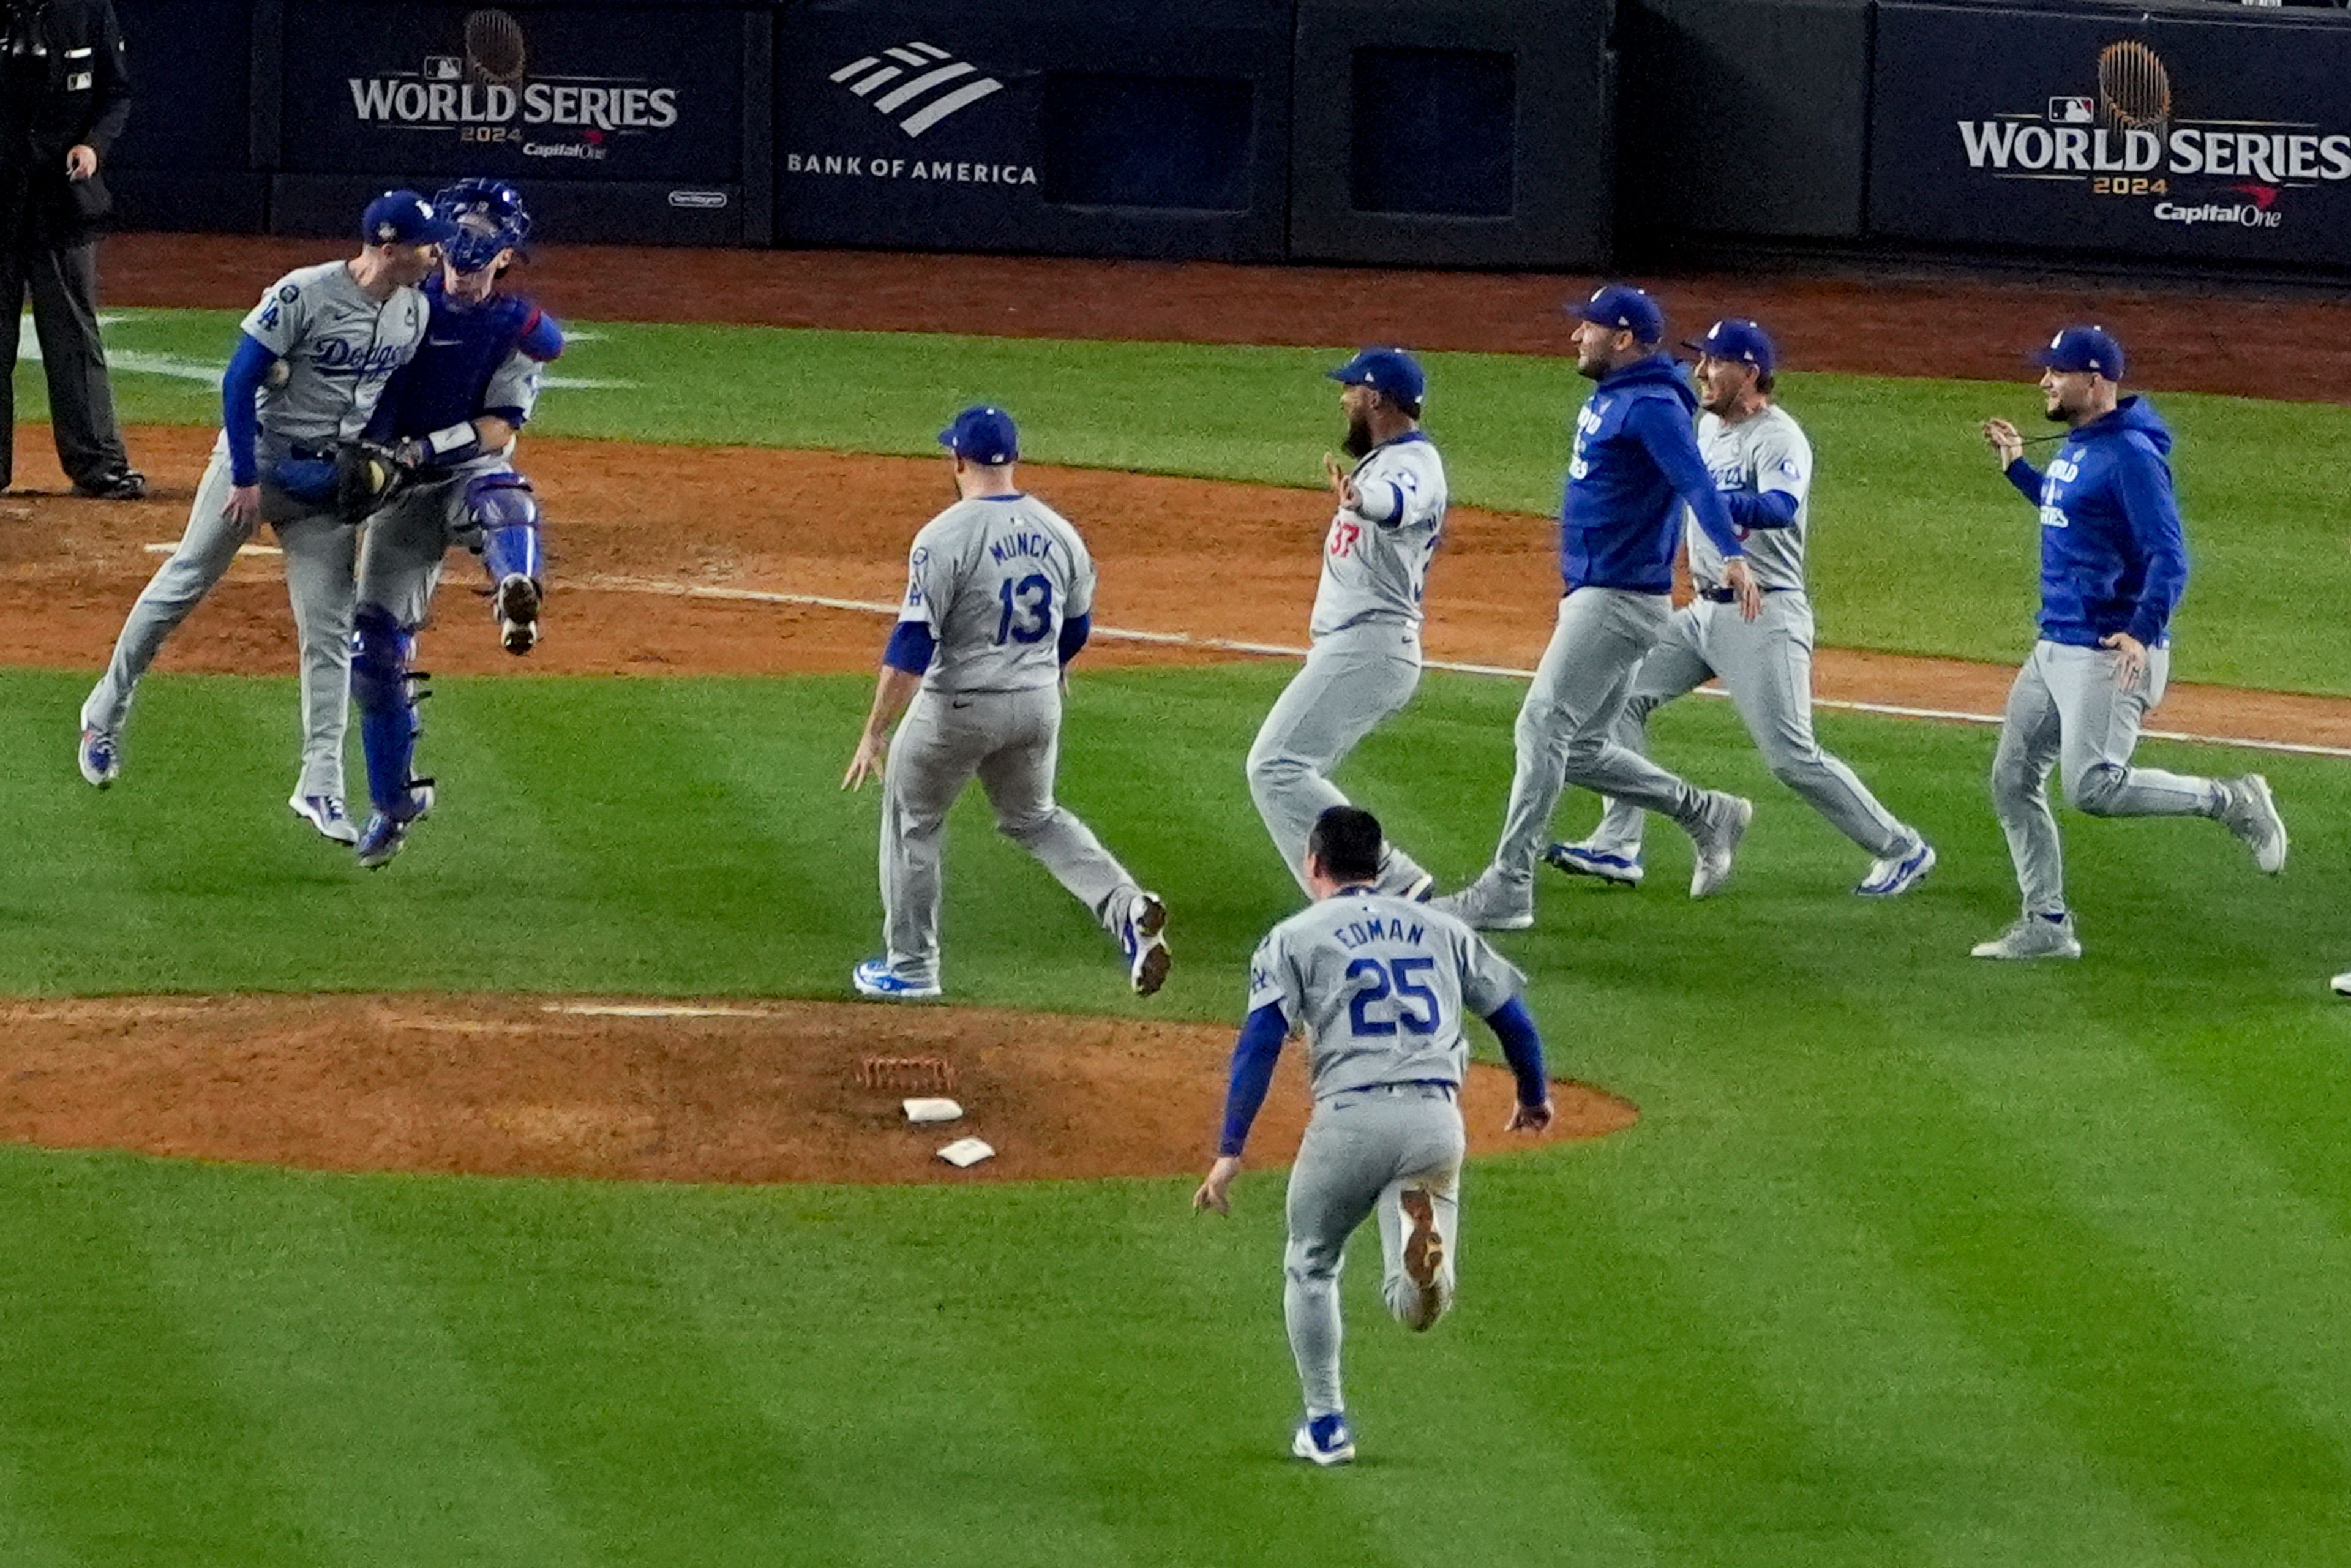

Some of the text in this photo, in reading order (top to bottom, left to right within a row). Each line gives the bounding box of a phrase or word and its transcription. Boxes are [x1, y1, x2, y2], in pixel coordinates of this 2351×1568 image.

[348, 78, 678, 130] WORLD SERIES
[461, 127, 522, 143] 2024
[1957, 121, 2351, 183] WORLD SERIES
[787, 153, 1037, 184] BANK OF AMERICA
[2093, 177, 2169, 195] 2024
[989, 532, 1053, 568] MUNCY
[1330, 520, 1360, 558] 37
[994, 573, 1053, 646] 13
[1334, 918, 1424, 950] EDMAN
[1346, 956, 1441, 1037] 25
